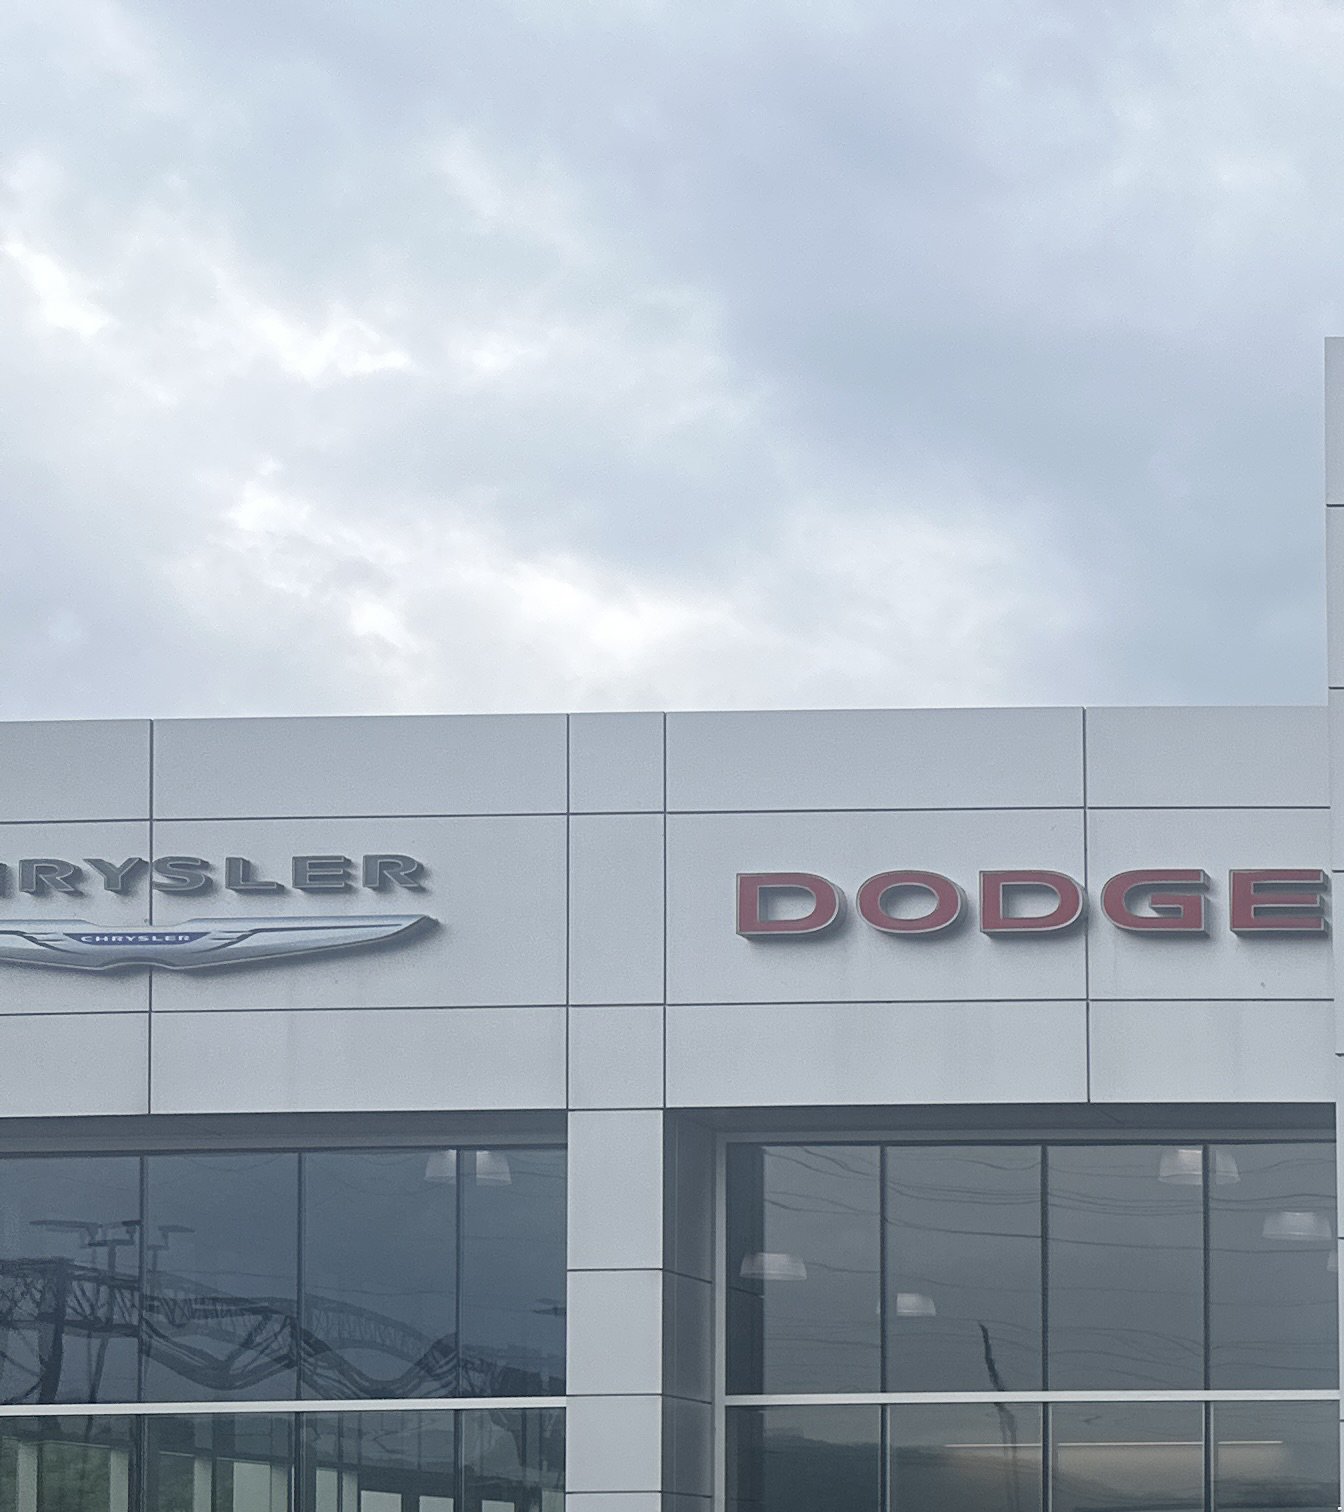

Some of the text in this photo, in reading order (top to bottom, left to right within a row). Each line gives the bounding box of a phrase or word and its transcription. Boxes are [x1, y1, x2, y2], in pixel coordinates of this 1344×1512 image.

[0, 854, 425, 896] RYSLER
[735, 868, 1329, 938] DODGE
[80, 935, 190, 943] CHRYSLER
